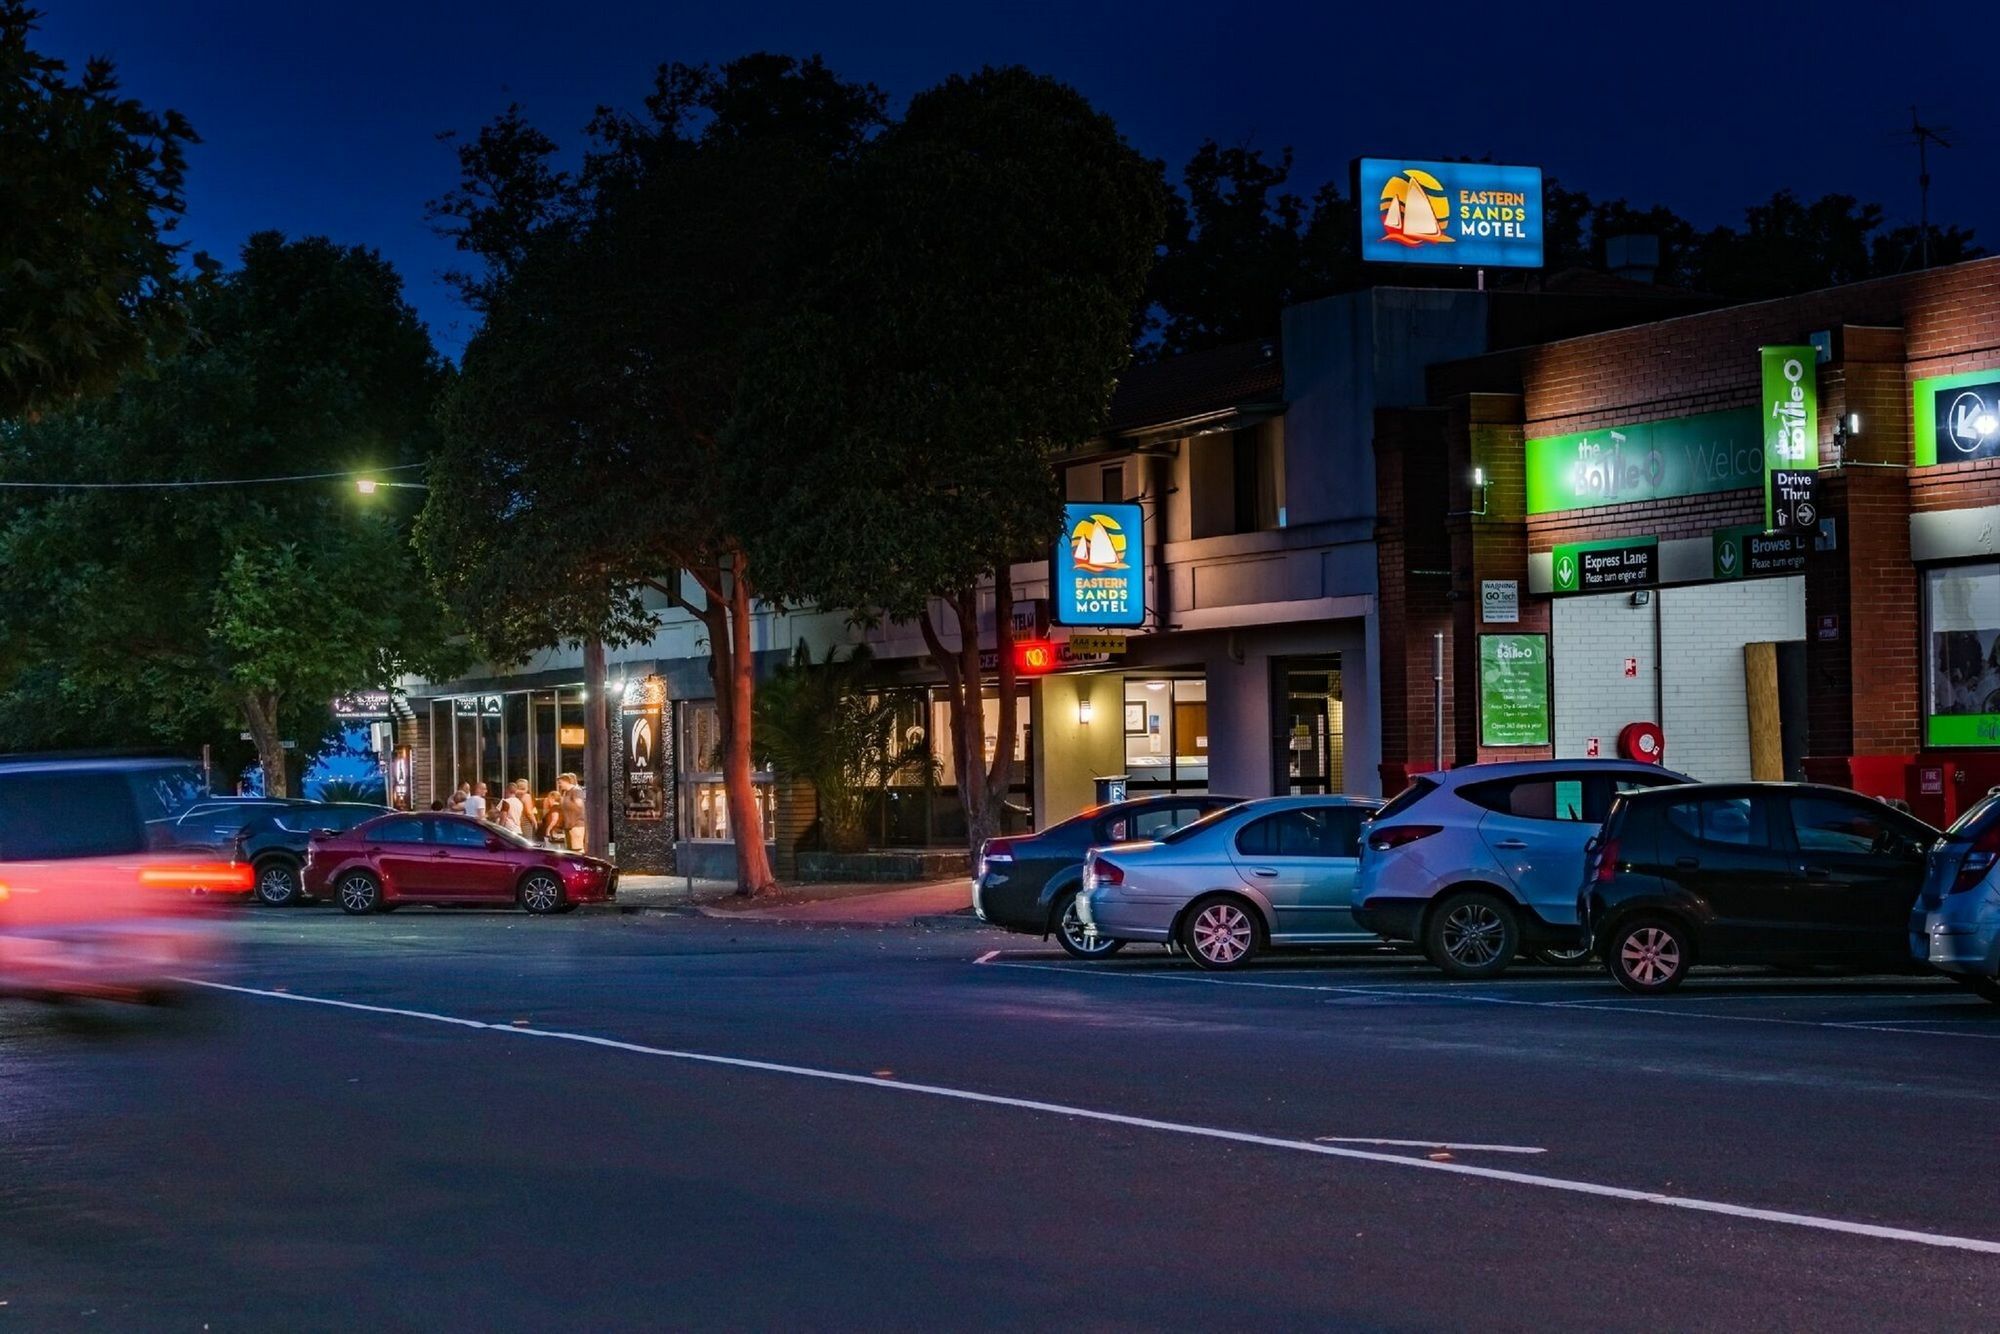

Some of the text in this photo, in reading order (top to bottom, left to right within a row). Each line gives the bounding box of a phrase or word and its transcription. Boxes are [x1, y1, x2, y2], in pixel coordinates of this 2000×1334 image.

[1460, 190, 1524, 206] EASTERN
[1460, 206, 1525, 221] SANDS
[1461, 221, 1526, 238] MOTEL
[1579, 438, 1600, 459] the
[1777, 473, 1812, 485] Drive
[1781, 488, 1811, 500] Thru
[1752, 538, 1792, 554] Browse
[1585, 550, 1648, 572] Express Lane
[1752, 558, 1771, 570] Please
[1773, 556, 1786, 568] turn
[1585, 567, 1648, 583] Please turn engine off
[1075, 577, 1128, 589] EASTERN
[1075, 589, 1128, 600] SANDS
[1485, 592, 1499, 600] GO
[1076, 601, 1128, 612] MOTEL
